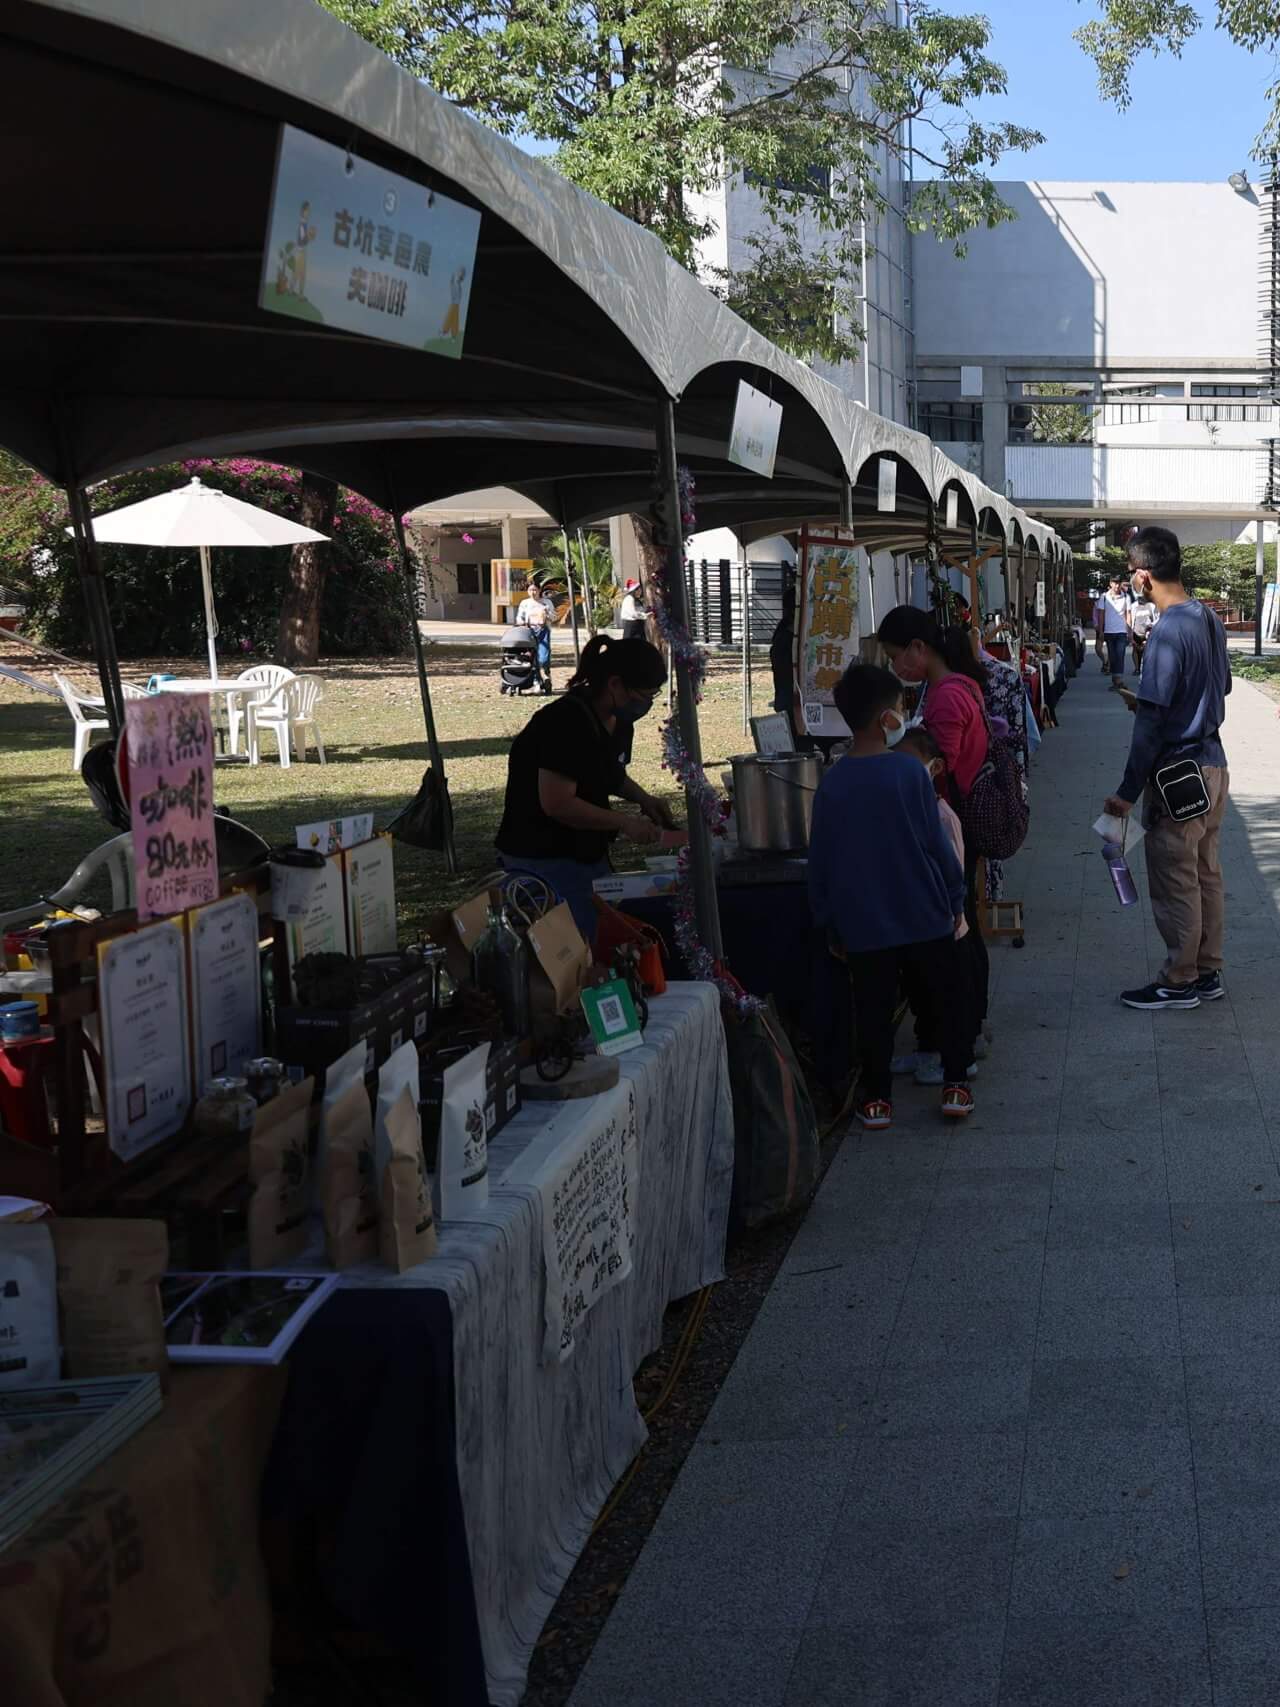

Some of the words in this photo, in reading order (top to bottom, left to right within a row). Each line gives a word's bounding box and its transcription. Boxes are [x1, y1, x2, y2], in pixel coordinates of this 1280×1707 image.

[385, 191, 396, 211] 3
[139, 766, 208, 826] 咖啡
[1175, 802, 1197, 815] adidas
